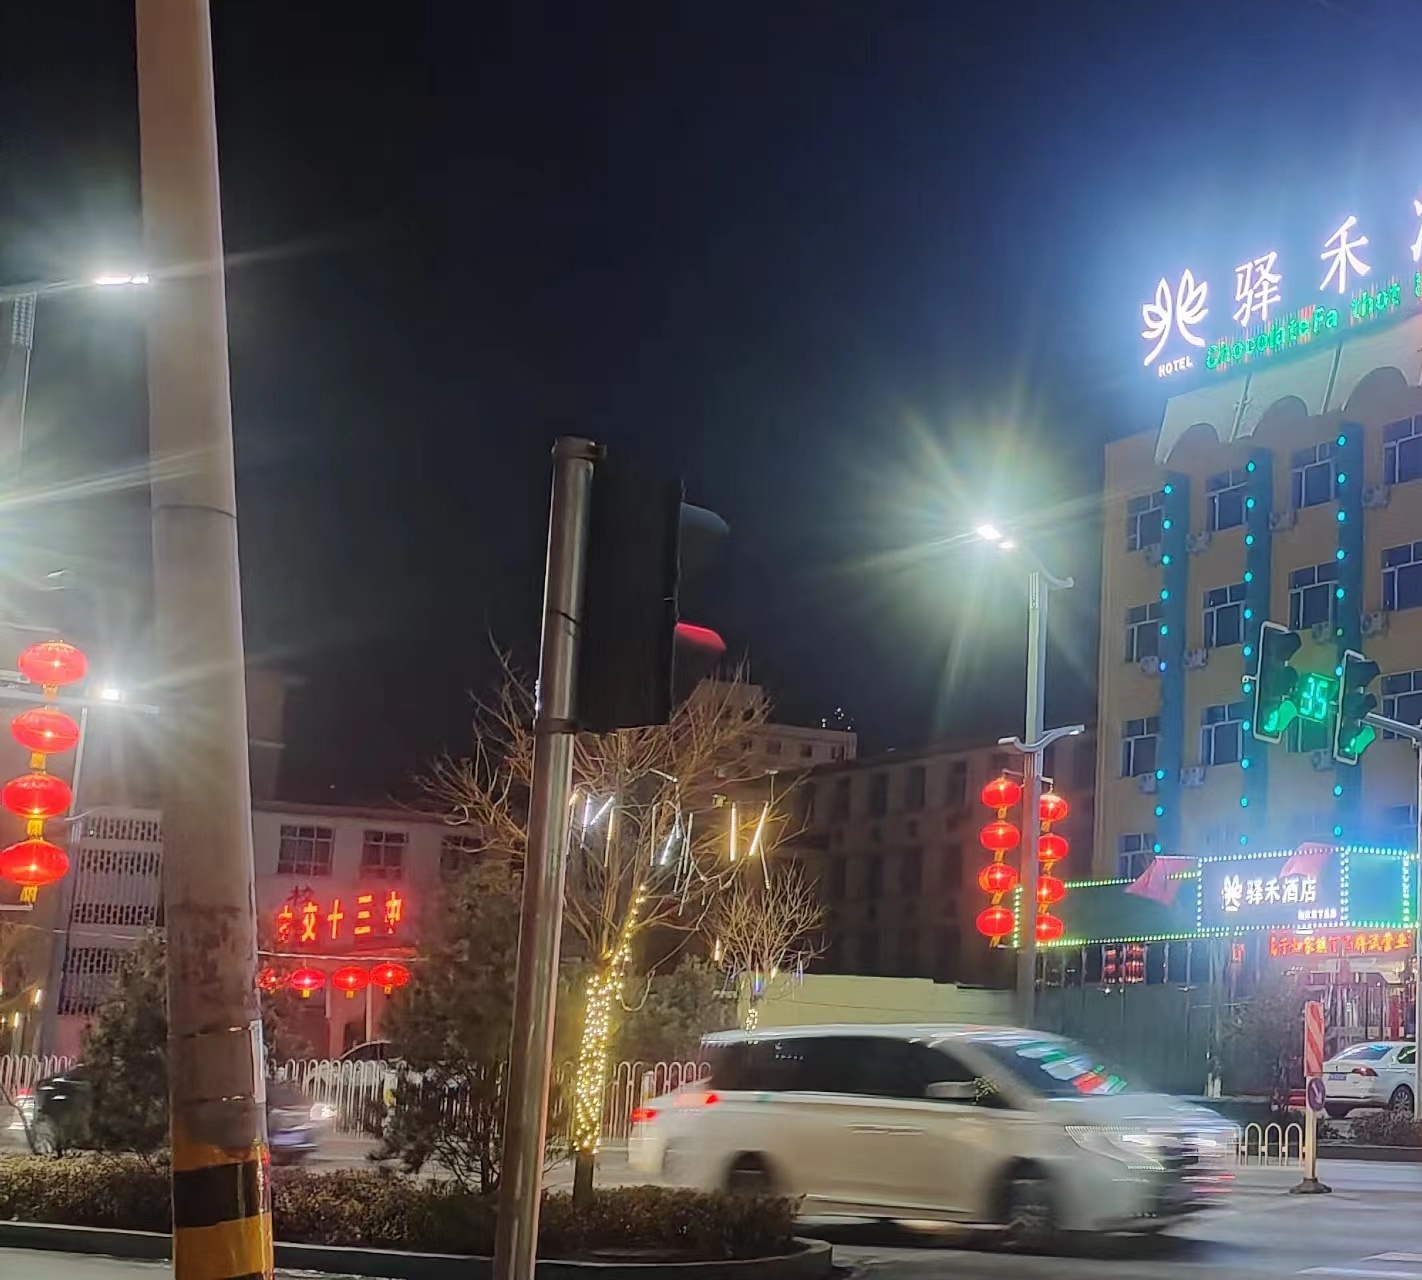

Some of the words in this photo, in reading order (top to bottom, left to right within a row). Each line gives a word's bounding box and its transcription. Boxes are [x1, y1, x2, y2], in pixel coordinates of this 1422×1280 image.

[1158, 356, 1194, 378] HOTEL
[1246, 876, 1317, 905] 驿禾酒店
